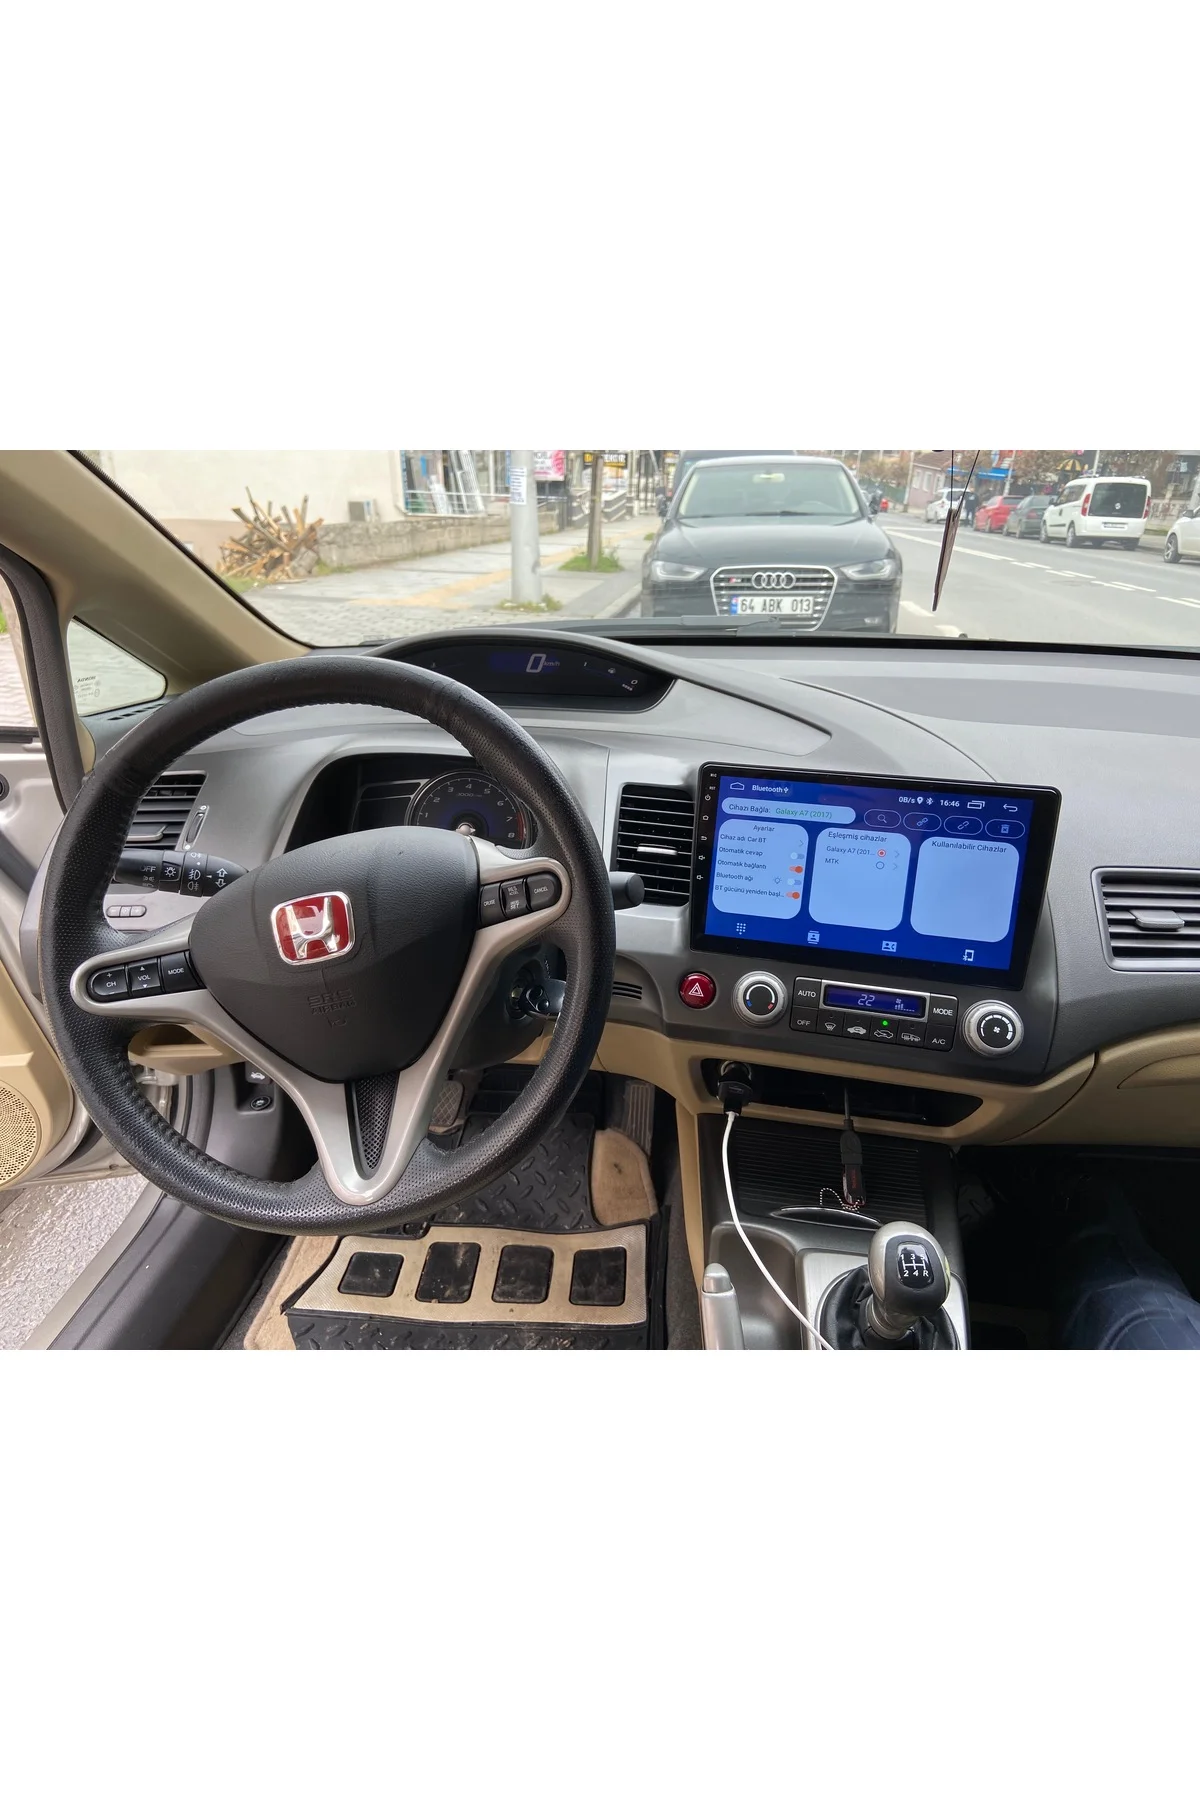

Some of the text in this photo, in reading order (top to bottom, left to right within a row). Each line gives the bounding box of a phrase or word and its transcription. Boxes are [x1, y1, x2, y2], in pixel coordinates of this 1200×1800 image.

[741, 598, 811, 612] 64 ABK 013
[526, 653, 546, 673] 0
[752, 784, 783, 793] Bluetooth
[899, 796, 960, 807] 0B/s 16:46
[750, 805, 771, 814] Bağla:
[775, 808, 798, 817] Galaxy
[799, 809, 808, 817] A7
[809, 810, 832, 819] (2017)
[720, 833, 736, 841] Cihaz
[828, 831, 887, 842] Eşleşmiş cihazlar
[719, 846, 744, 854] Otomatik
[826, 845, 846, 855] Galaxy
[931, 840, 1007, 853] Kullanılabilir Cihazlar
[717, 859, 743, 867] Otomatik
[716, 872, 744, 880] Bluetooth
[534, 886, 548, 894] CANCEL
[723, 885, 745, 893] gücünü
[745, 888, 768, 896] yeniden
[167, 967, 185, 975] MODE
[797, 990, 817, 998] AUTO
[857, 993, 875, 1007] 22
[932, 1007, 954, 1016] MODE
[931, 1037, 946, 1045] A/C
[922, 1269, 929, 1277] R
